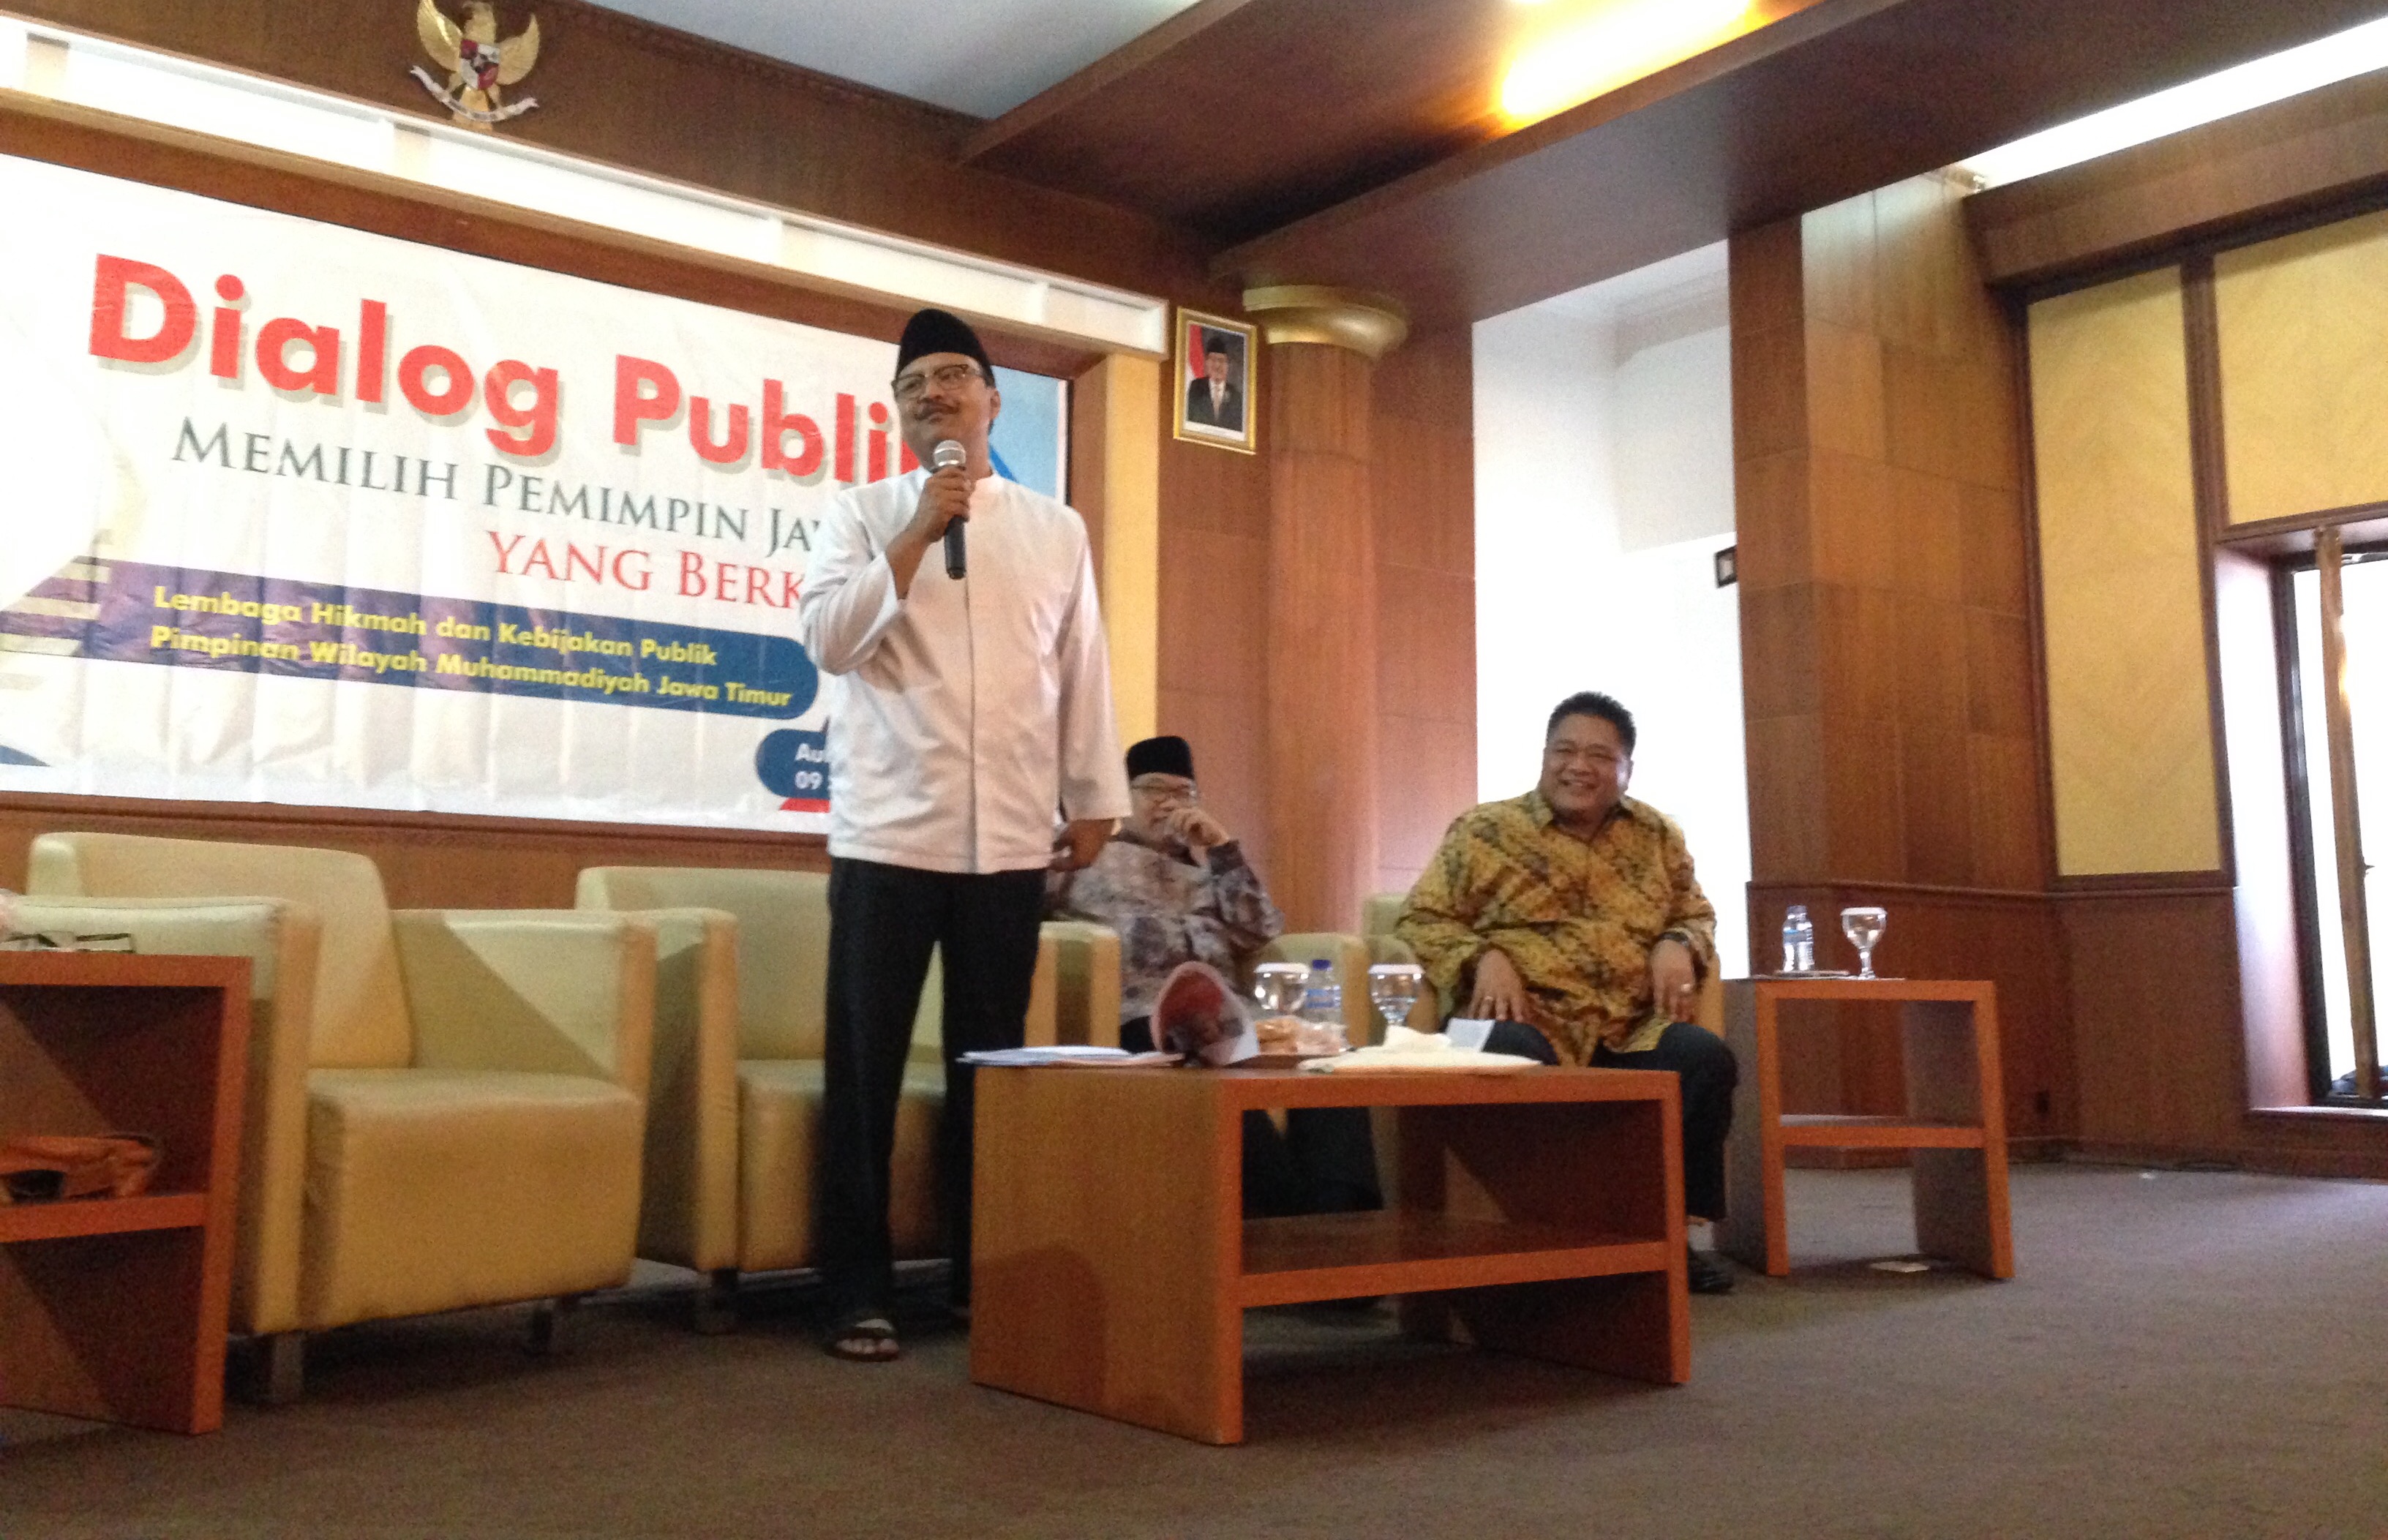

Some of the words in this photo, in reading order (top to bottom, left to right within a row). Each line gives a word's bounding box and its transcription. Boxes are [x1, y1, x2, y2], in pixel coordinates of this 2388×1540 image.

[89, 253, 558, 457] Dialog
[171, 416, 458, 500] MEMILIH
[483, 464, 749, 542] PEMIMPIN
[765, 508, 820, 558] JA
[486, 530, 653, 591] YANG
[151, 625, 300, 661] Pimpinan
[309, 641, 428, 674] Wilayah
[436, 653, 650, 695] Muhammadiyah
[658, 676, 719, 701] Jawa
[725, 682, 794, 707] Timur
[153, 586, 303, 626] Lembaga
[311, 602, 427, 636] Hikmah
[436, 617, 490, 641] dan
[497, 623, 633, 658] Kebijakan
[641, 639, 718, 666] Publik
